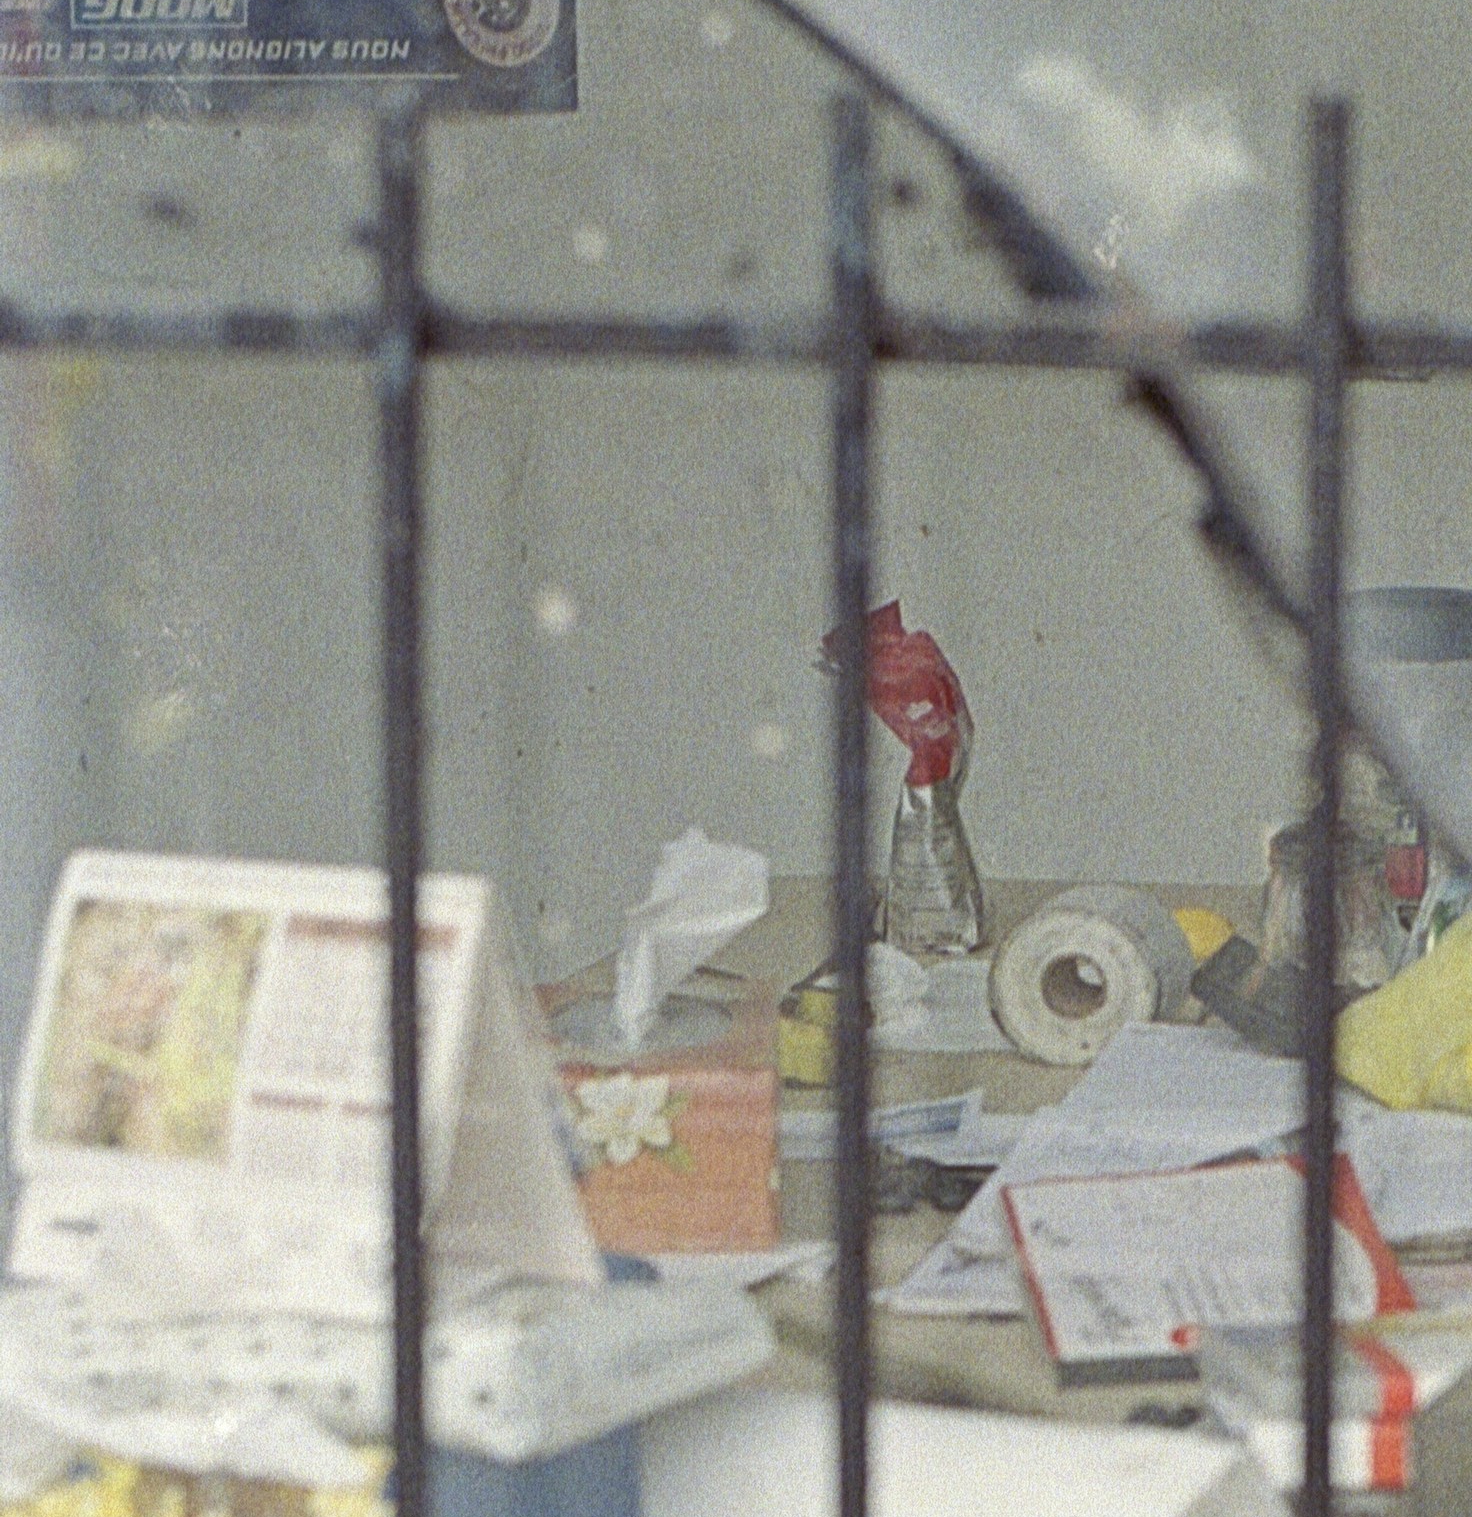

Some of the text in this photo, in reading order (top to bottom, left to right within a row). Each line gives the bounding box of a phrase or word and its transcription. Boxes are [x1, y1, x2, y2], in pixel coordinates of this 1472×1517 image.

[69, 40, 106, 61] CE
[112, 40, 184, 61] AVEC
[187, 39, 326, 61] ALIGNONS
[331, 38, 411, 61] NOUS
